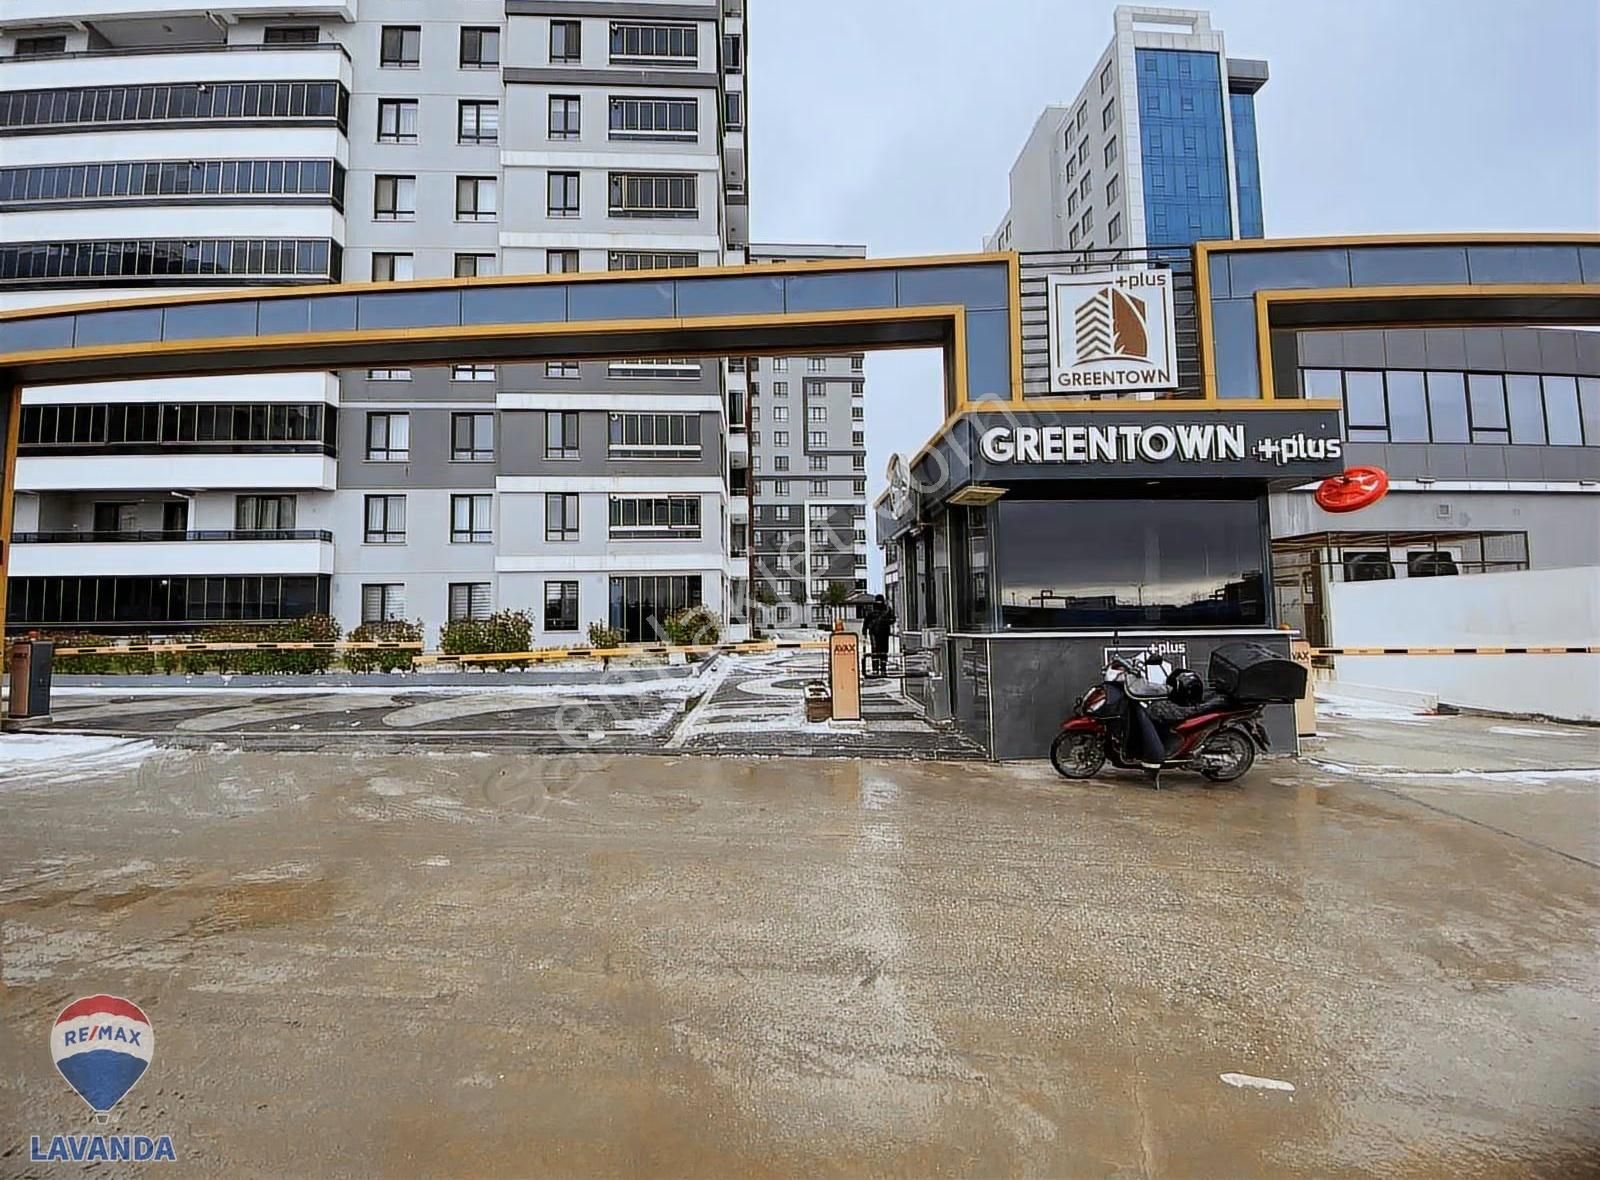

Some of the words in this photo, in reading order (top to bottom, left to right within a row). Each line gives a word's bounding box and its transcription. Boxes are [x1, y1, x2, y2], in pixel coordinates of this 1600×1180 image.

[1115, 272, 1166, 289] +plus
[1057, 369, 1171, 387] GREENTOWN
[980, 424, 1246, 462] GREENTOWN
[1149, 640, 1186, 656] +plus
[1291, 651, 1310, 661] VAX
